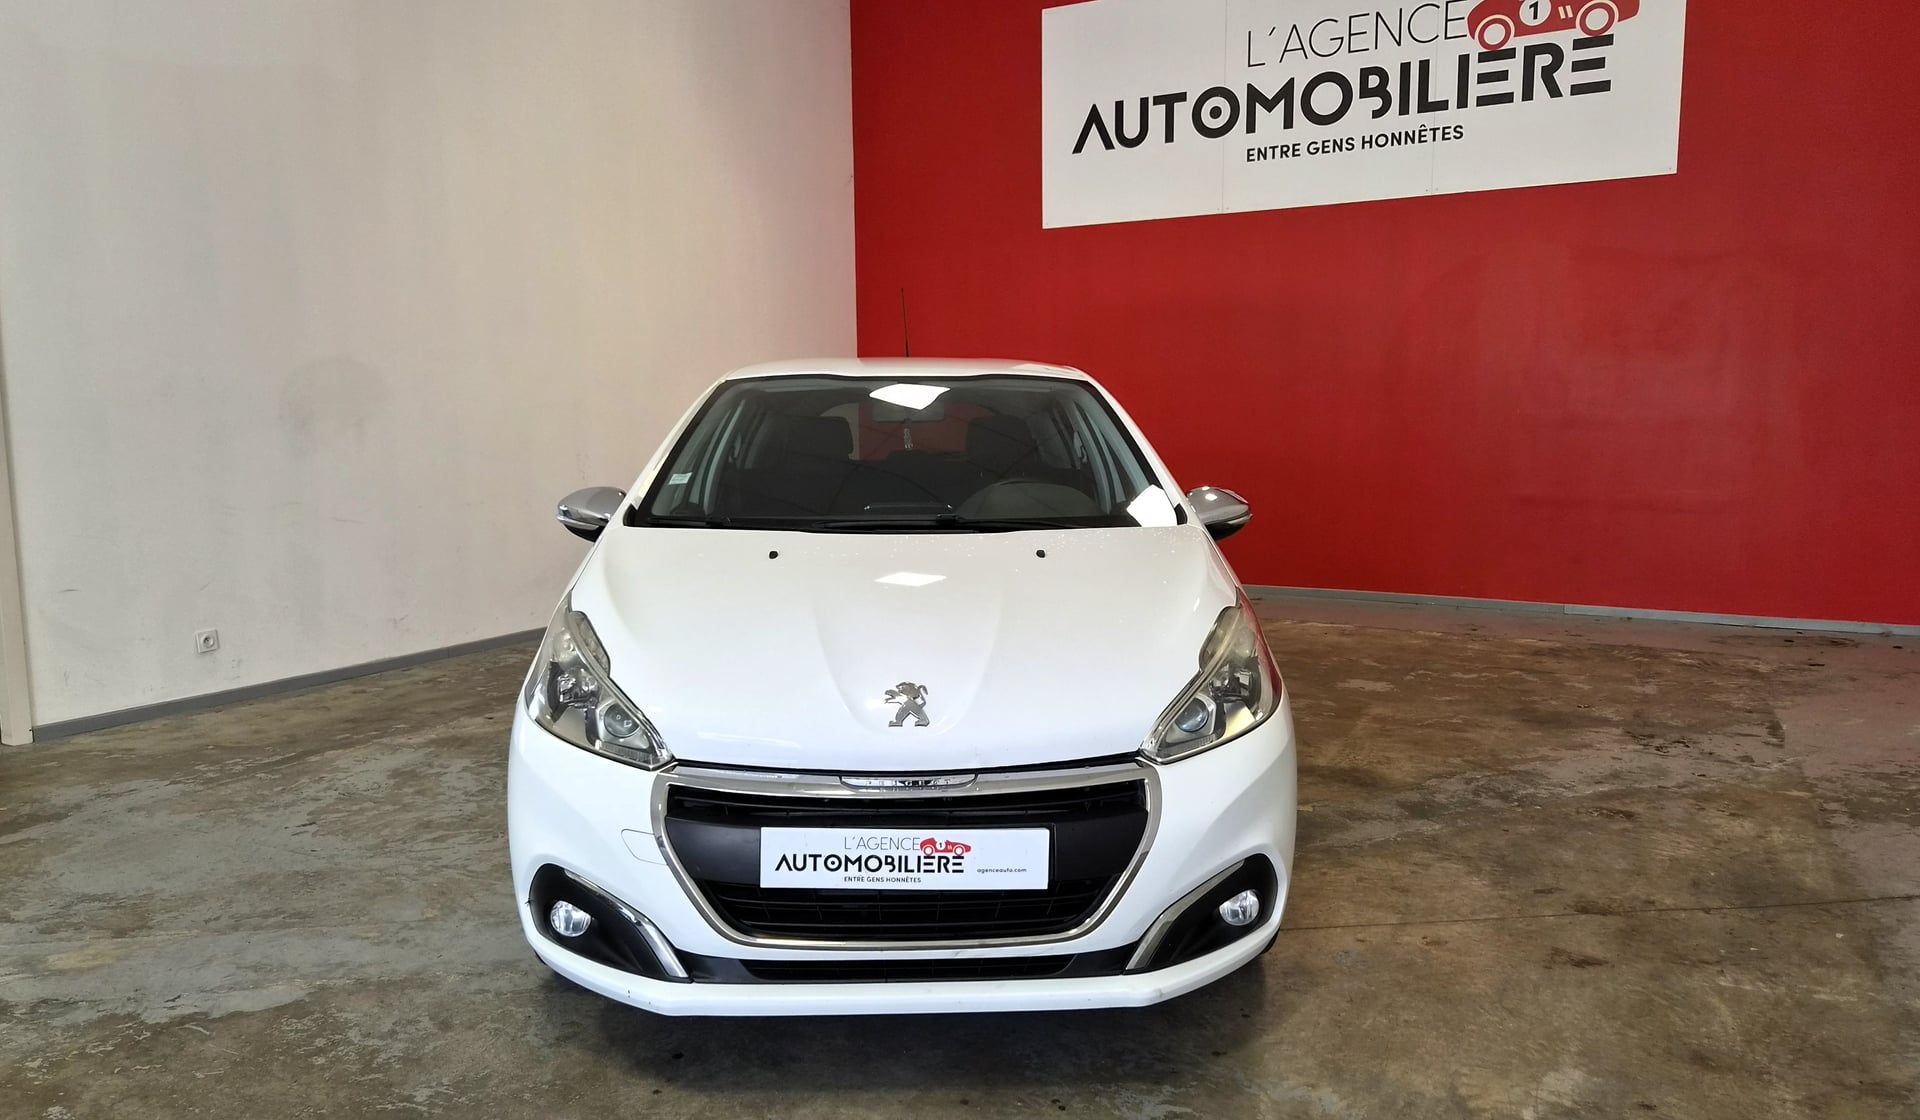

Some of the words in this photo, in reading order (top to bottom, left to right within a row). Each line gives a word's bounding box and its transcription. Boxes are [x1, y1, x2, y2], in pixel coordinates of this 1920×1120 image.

[1528, 1, 1539, 20] 1
[1246, 143, 1301, 162] ENTRE
[1306, 136, 1356, 155] GENS
[1361, 124, 1464, 150] HONNÊTES
